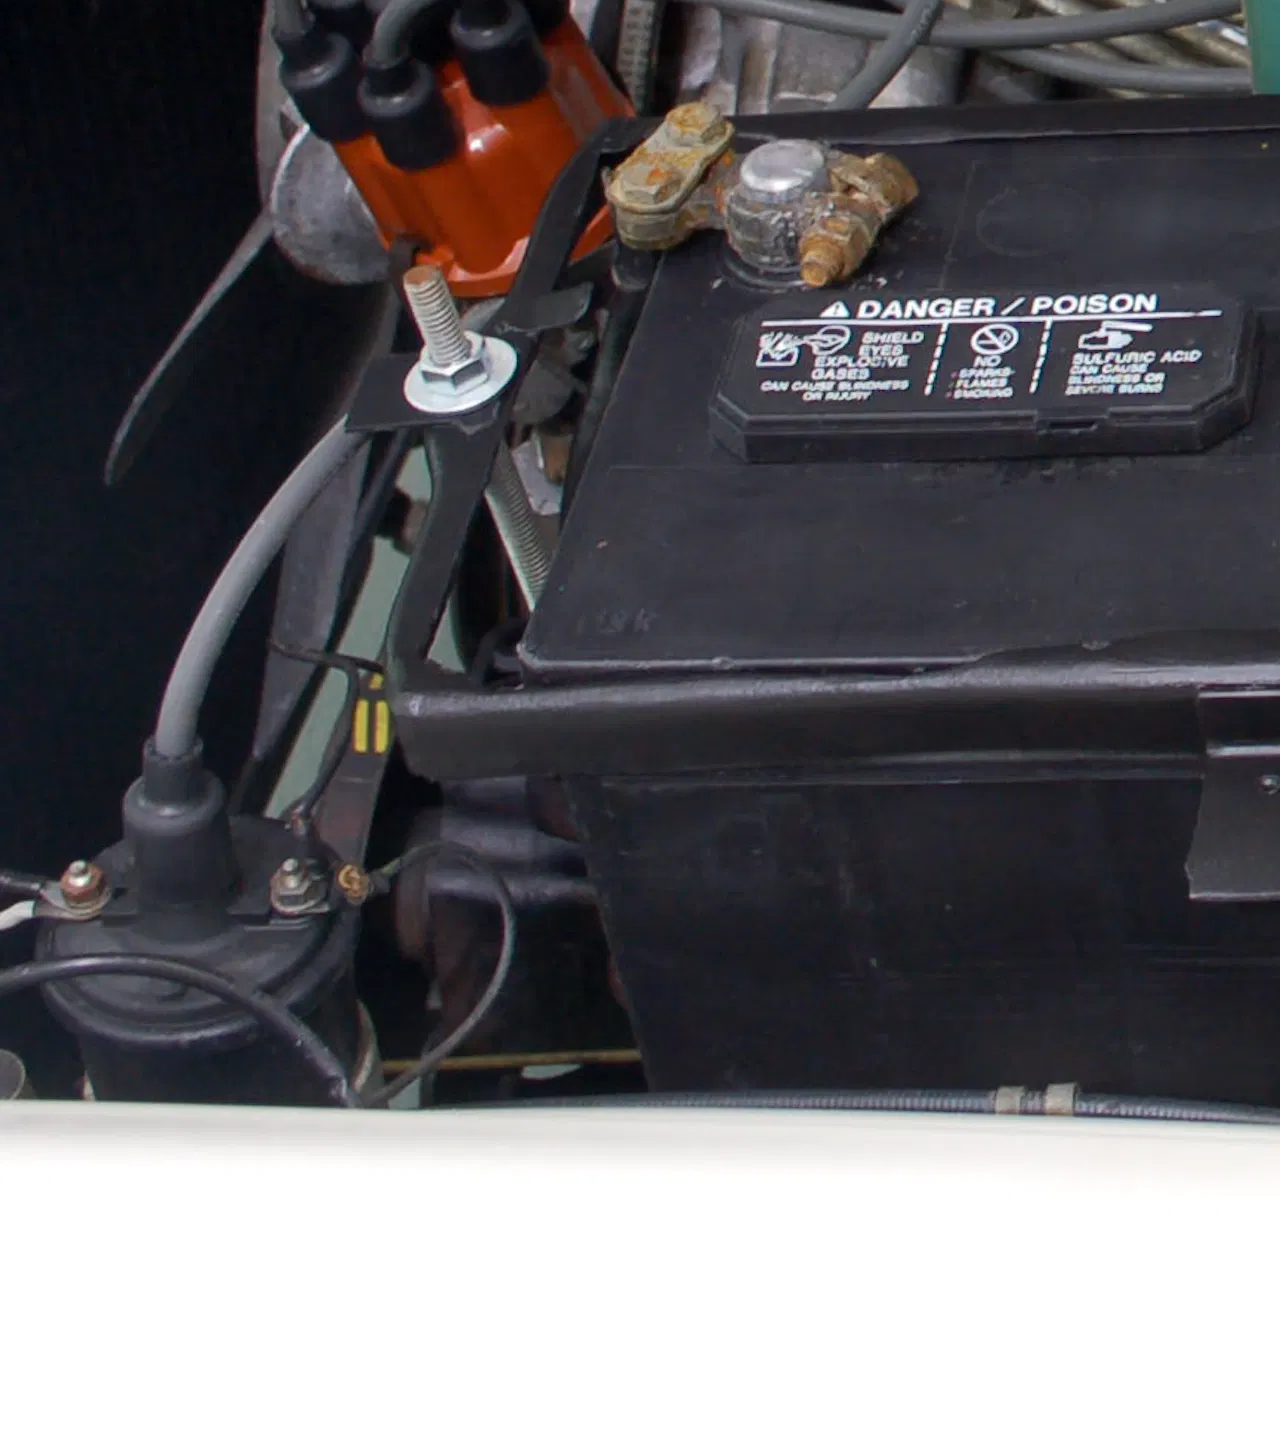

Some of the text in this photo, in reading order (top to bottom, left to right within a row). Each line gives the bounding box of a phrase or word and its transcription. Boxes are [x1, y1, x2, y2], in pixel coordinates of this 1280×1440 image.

[856, 292, 1158, 319] DANGER / POISON
[861, 330, 925, 345] SHIELD
[858, 344, 904, 357] EYES
[1071, 348, 1203, 366] SULFURIC ACID
[813, 354, 911, 369] EXPLOSIVE
[972, 354, 1003, 368] NO
[810, 367, 871, 381] GASES
[1068, 363, 1149, 376] CAN CAUSE
[955, 376, 1009, 390] FLAMES
[1066, 371, 1166, 385] BLINDNESS OR
[760, 379, 910, 392] CAN CAUSE BLINDNESS
[1118, 382, 1164, 395] BURNS
[802, 391, 824, 401] OR
[953, 386, 1014, 400] SMOKING
